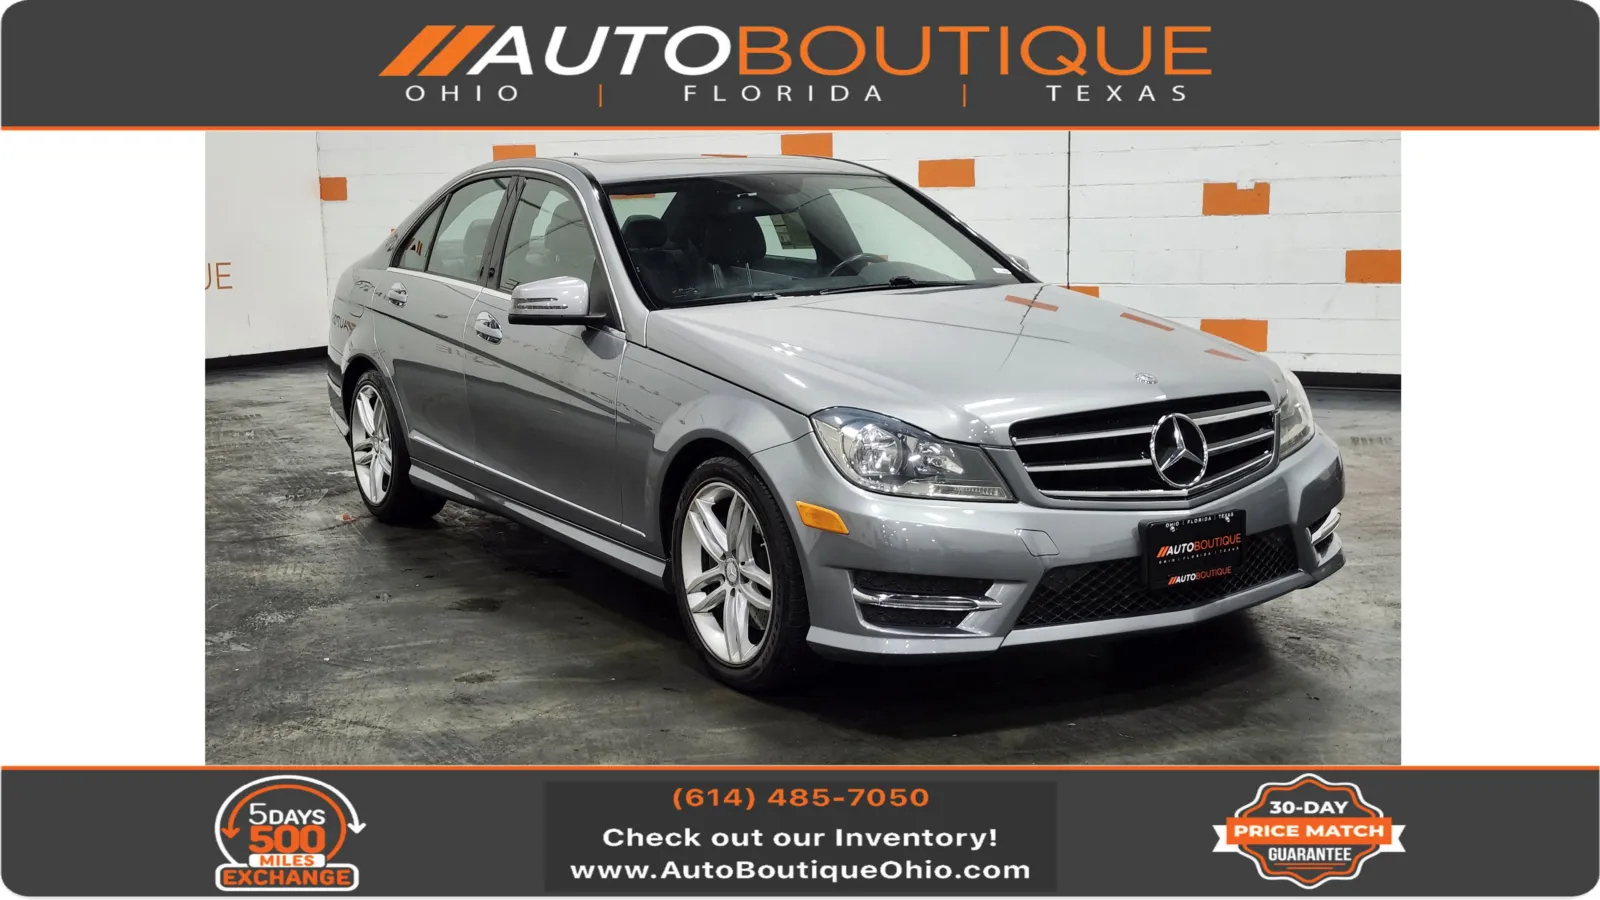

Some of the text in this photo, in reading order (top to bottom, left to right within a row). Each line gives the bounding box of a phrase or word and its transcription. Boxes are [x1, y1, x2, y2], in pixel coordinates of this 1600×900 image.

[1187, 516, 1212, 525] FLORIDA
[1166, 533, 1241, 556] AUTOBOUTIQUE
[1175, 566, 1232, 584] AUTOBOUTIQUE
